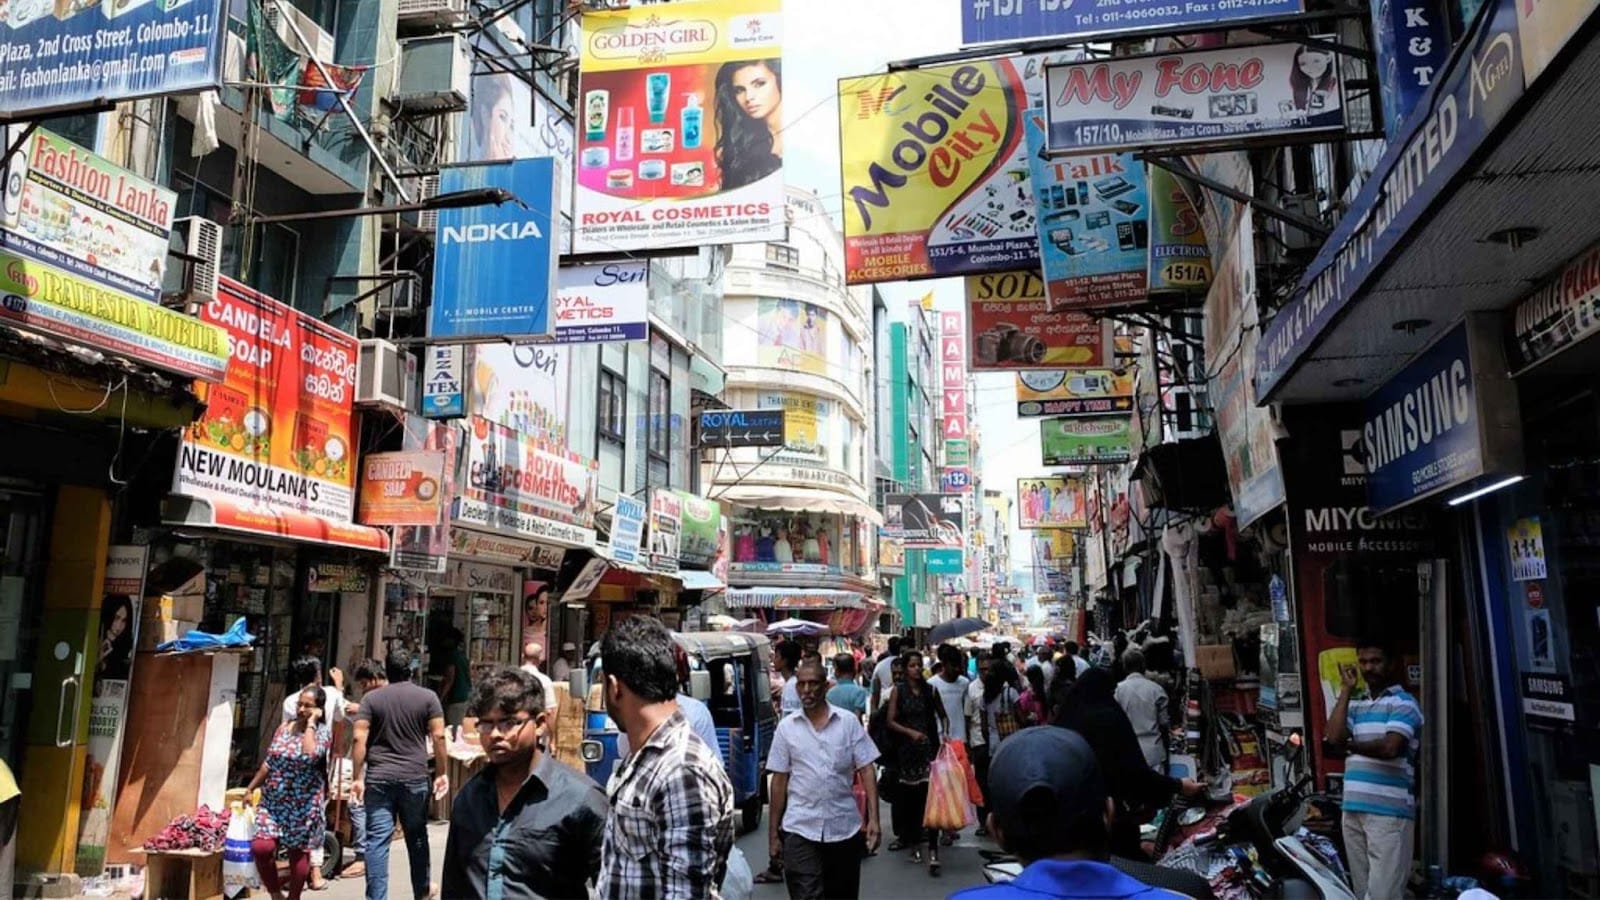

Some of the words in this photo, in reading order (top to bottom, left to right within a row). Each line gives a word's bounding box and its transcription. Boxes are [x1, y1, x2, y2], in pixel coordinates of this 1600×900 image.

[1074, 15, 1093, 25] Tel
[1102, 6, 1182, 22] 011-4060032,
[1185, 3, 1208, 13] Fax
[0, 42, 33, 62] Plaza,
[37, 34, 60, 57] 2nd
[62, 34, 93, 54] Cross
[94, 25, 133, 49] Street,
[137, 14, 211, 43] Colombo-11.
[594, 31, 666, 50] GOLDEN
[670, 28, 709, 43] GIRL
[20, 53, 165, 89] fashonlanka@gmail.com
[1056, 64, 1143, 110] My
[1155, 56, 1264, 97] Fone
[1074, 123, 1124, 146] 157/10,
[1126, 129, 1151, 141] Mobile
[1153, 127, 1177, 138] Plaza,
[1179, 126, 1195, 136] 2nd
[1196, 124, 1221, 135] Cross
[850, 65, 986, 231] Mobile
[929, 108, 1001, 188] City
[1046, 155, 1124, 182] Talk
[1375, 94, 1458, 239] LIMITED
[34, 135, 110, 199] Fashion
[115, 175, 168, 226] Lanka
[582, 210, 646, 225] ROYAL
[652, 203, 770, 221] COSMETICS
[442, 221, 542, 244] NOKIA
[968, 240, 1003, 253] Mumbai
[1005, 239, 1031, 252] Plaza,
[970, 251, 1027, 264] Colombo-11.
[848, 263, 928, 280] ACCESSORIES
[864, 253, 911, 267] MOBILE
[1166, 264, 1206, 280] 151/A
[978, 274, 1046, 298] SOL
[501, 305, 534, 314] CENTER
[147, 307, 218, 356] MOBILE
[208, 299, 292, 349] CANDELA
[1268, 329, 1296, 371] WALK
[1304, 277, 1334, 327] TALK
[228, 336, 272, 368] SOAP
[945, 316, 962, 433] RAMYA
[427, 382, 459, 394] TEX
[1044, 400, 1080, 413] HAPPY
[1364, 359, 1468, 473] SAMSUNG
[701, 413, 748, 427] ROYAL
[181, 446, 226, 477] NEW
[228, 459, 319, 501] MOULANA'S
[526, 451, 566, 483] ROYAL
[179, 474, 213, 490] Wholesale
[221, 484, 238, 495] Retail
[503, 464, 579, 505] COSMETICS
[1341, 477, 1367, 486] MIY
[1308, 541, 1353, 553] MOBILE
